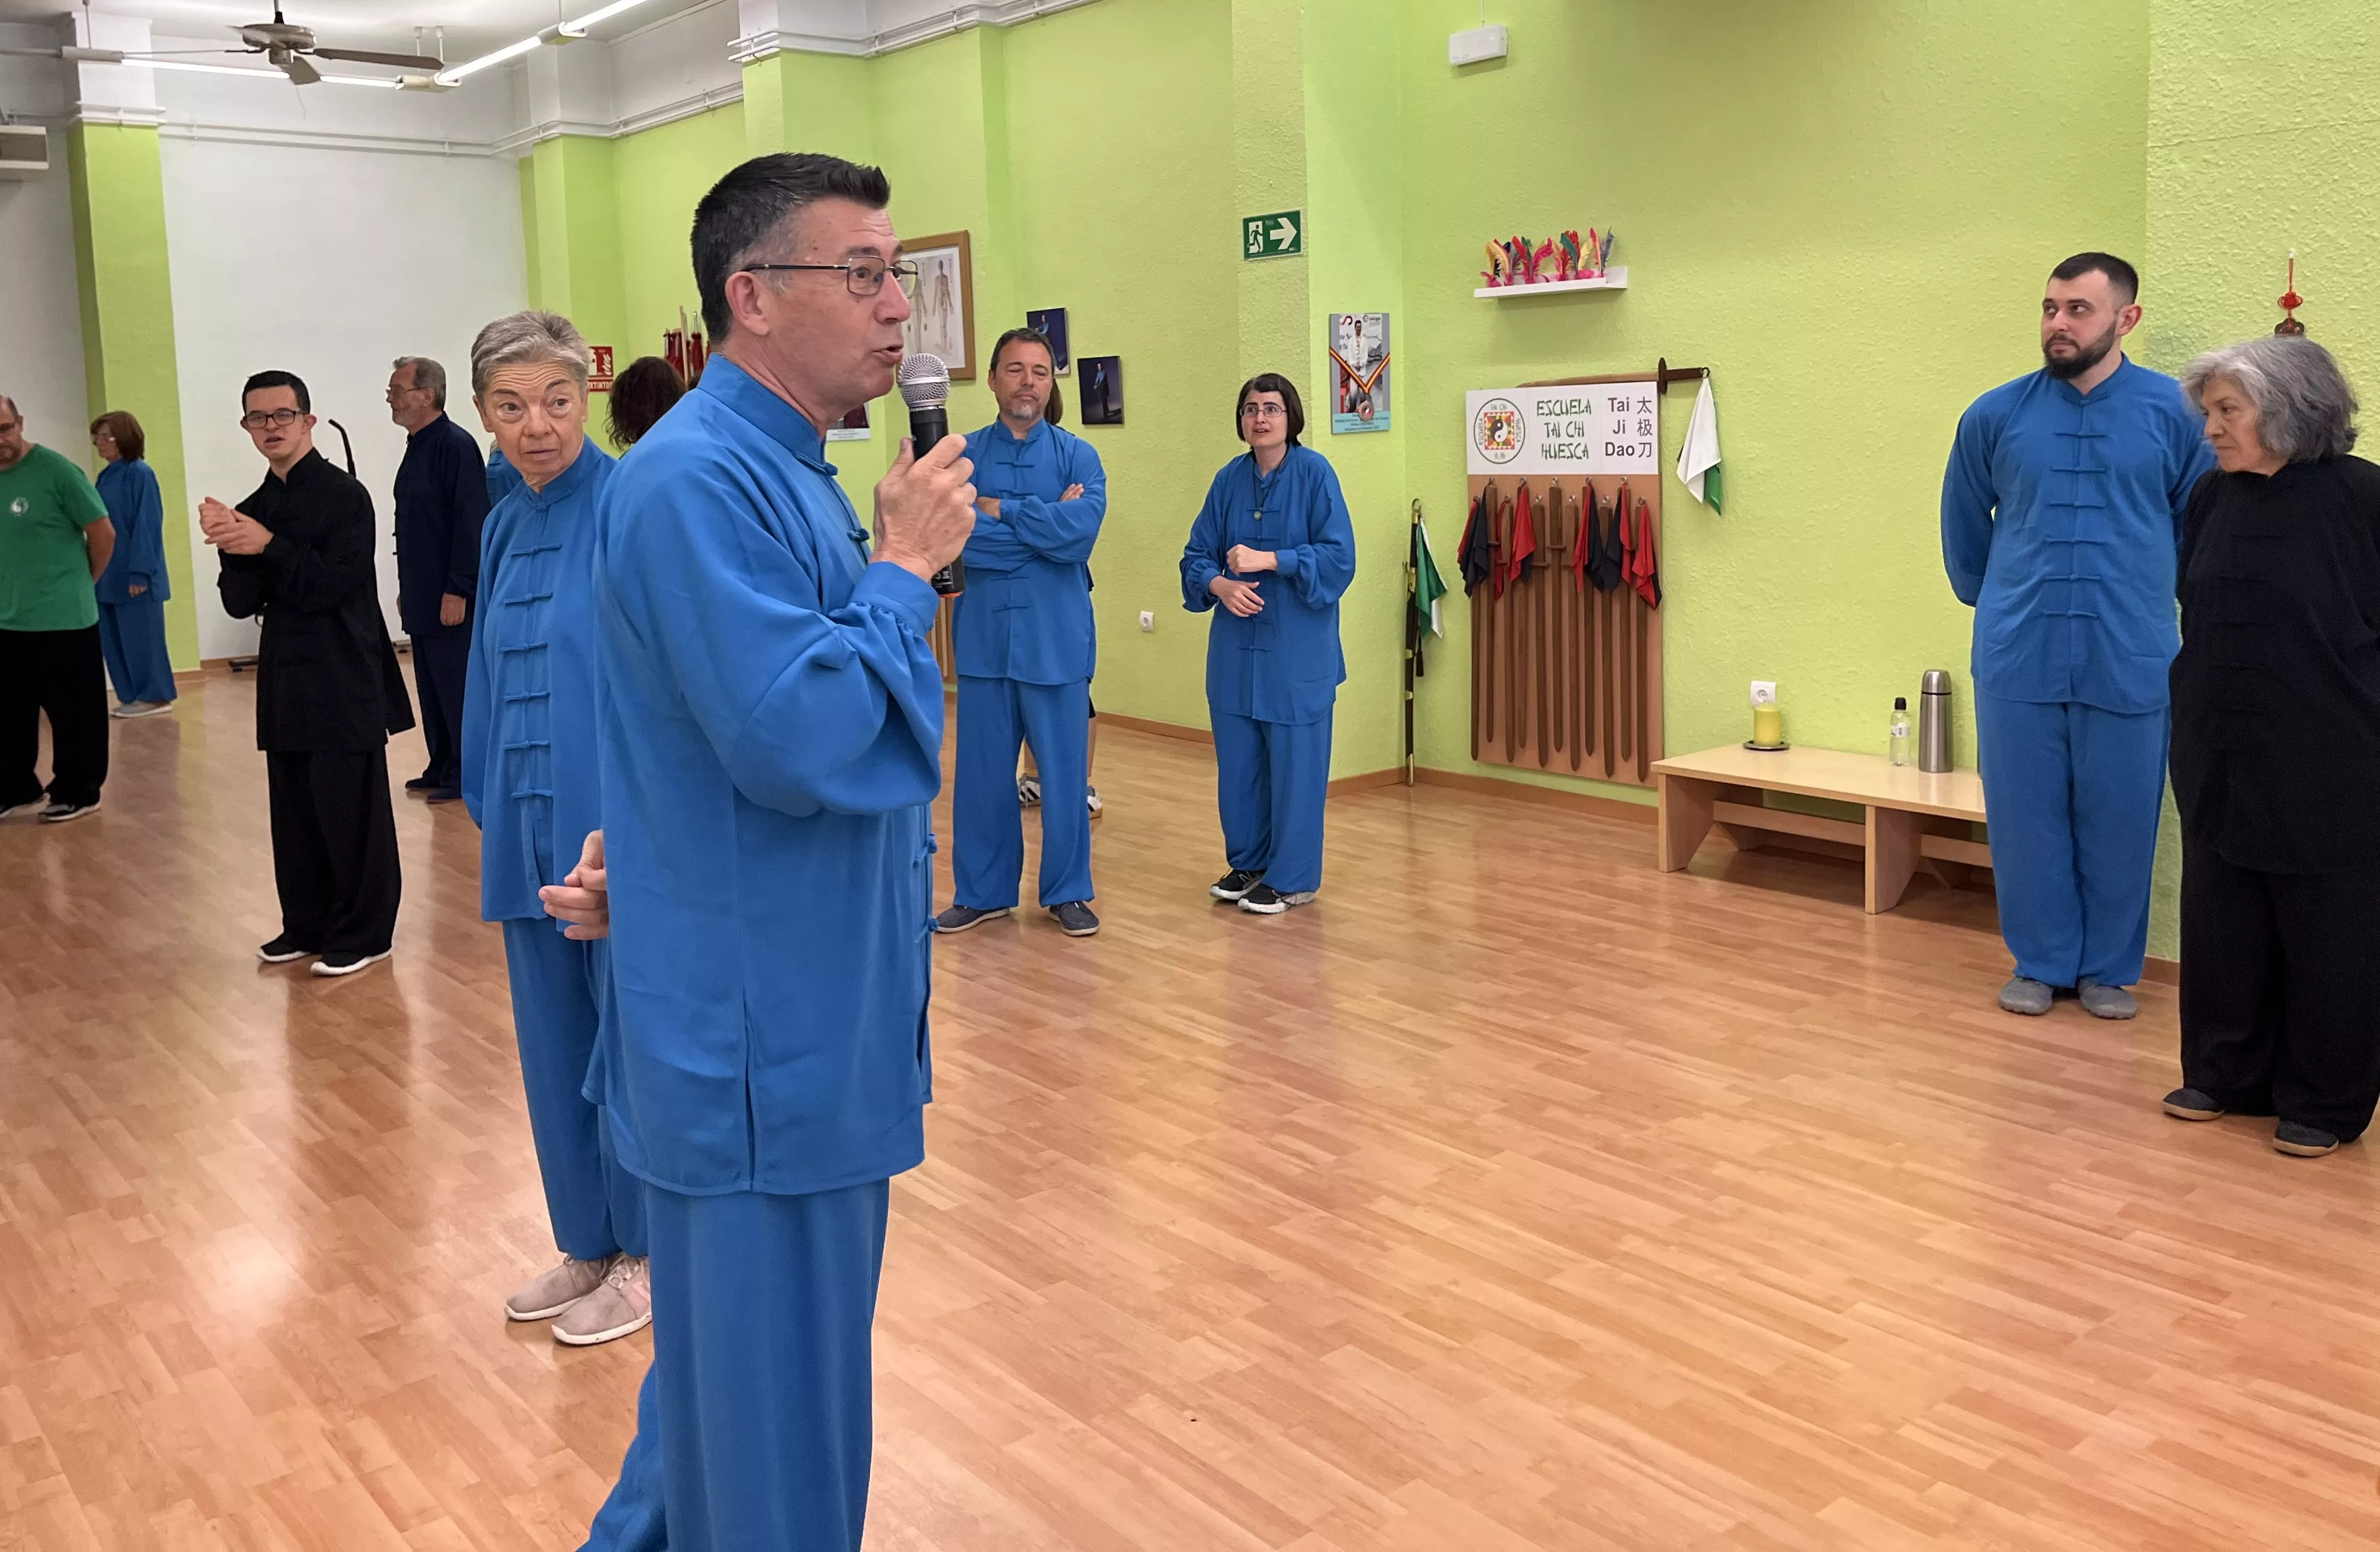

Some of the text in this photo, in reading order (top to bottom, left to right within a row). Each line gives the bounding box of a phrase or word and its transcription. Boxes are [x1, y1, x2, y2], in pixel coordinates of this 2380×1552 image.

[1537, 398, 1591, 416] ESCUELA
[1608, 396, 1652, 415] Tai 太
[1544, 421, 1585, 438] TAI CHI
[1613, 419, 1626, 434] Ji
[1541, 442, 1590, 460] HUESCA
[1605, 442, 1652, 458] Dao 刀
